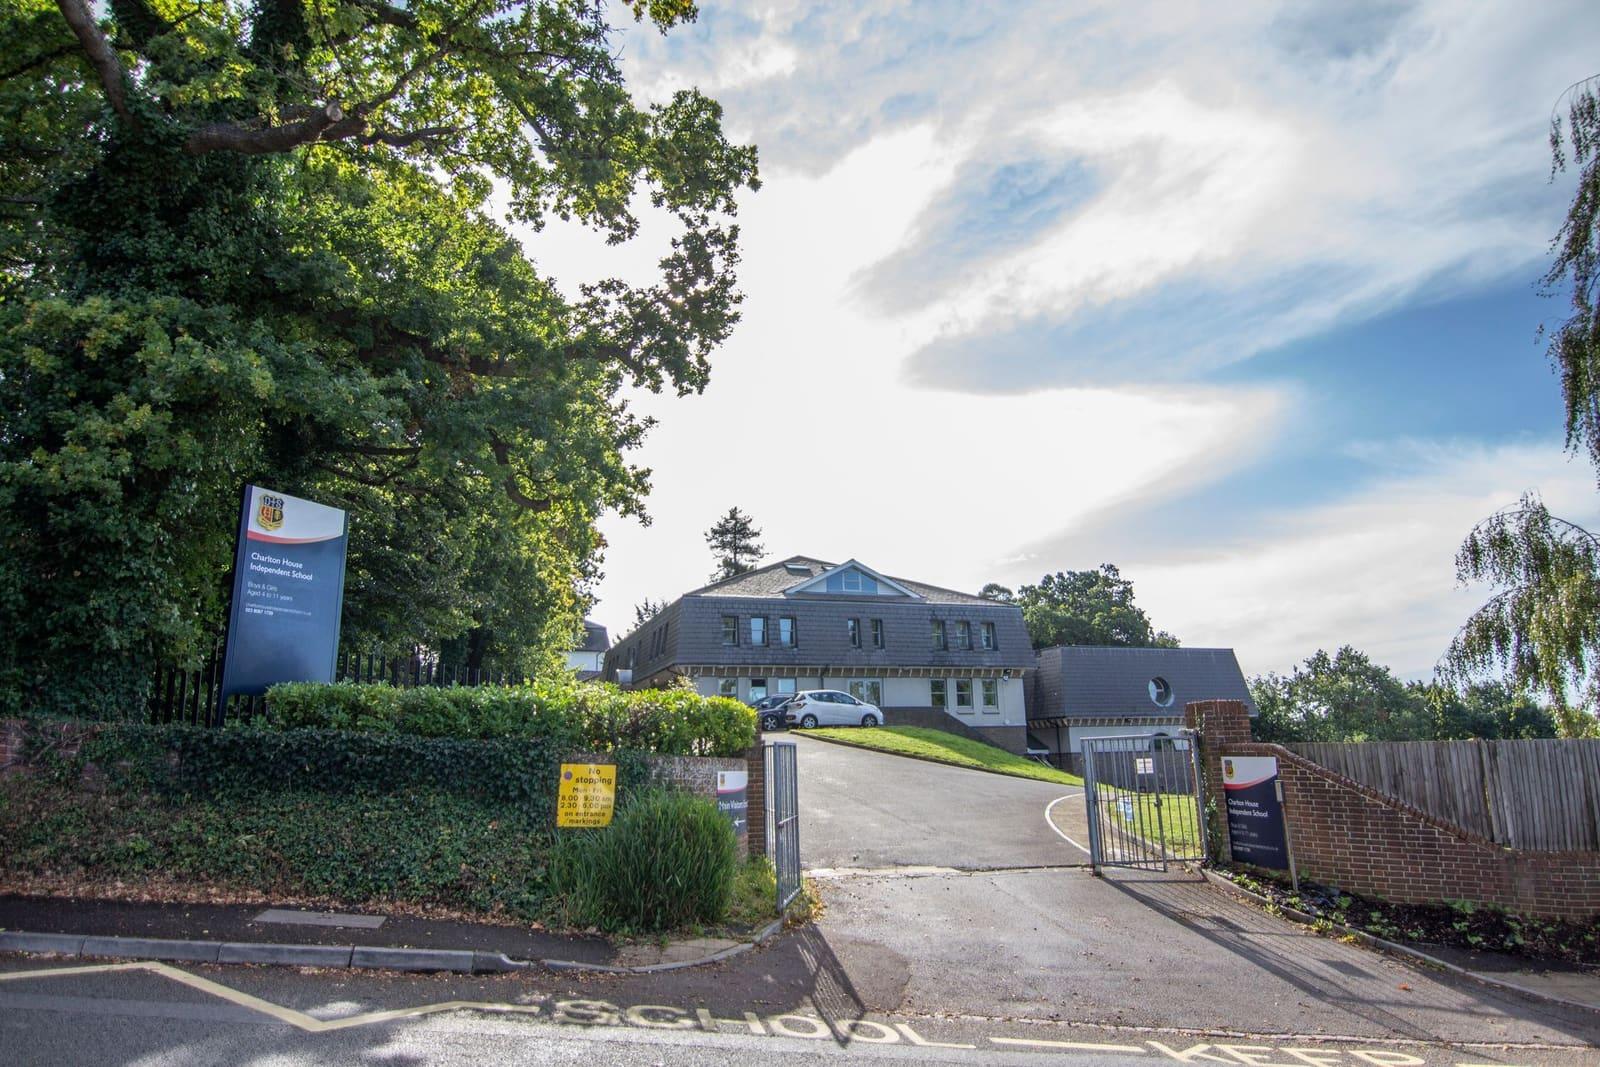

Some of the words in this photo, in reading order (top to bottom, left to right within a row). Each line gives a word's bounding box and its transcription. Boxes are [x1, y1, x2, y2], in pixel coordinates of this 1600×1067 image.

[251, 552, 281, 565] Charlton
[282, 557, 303, 569] House
[250, 563, 291, 577] Independent
[292, 570, 313, 581] School
[575, 776, 612, 785] stopping
[552, 1000, 977, 1049] SCHOOL
